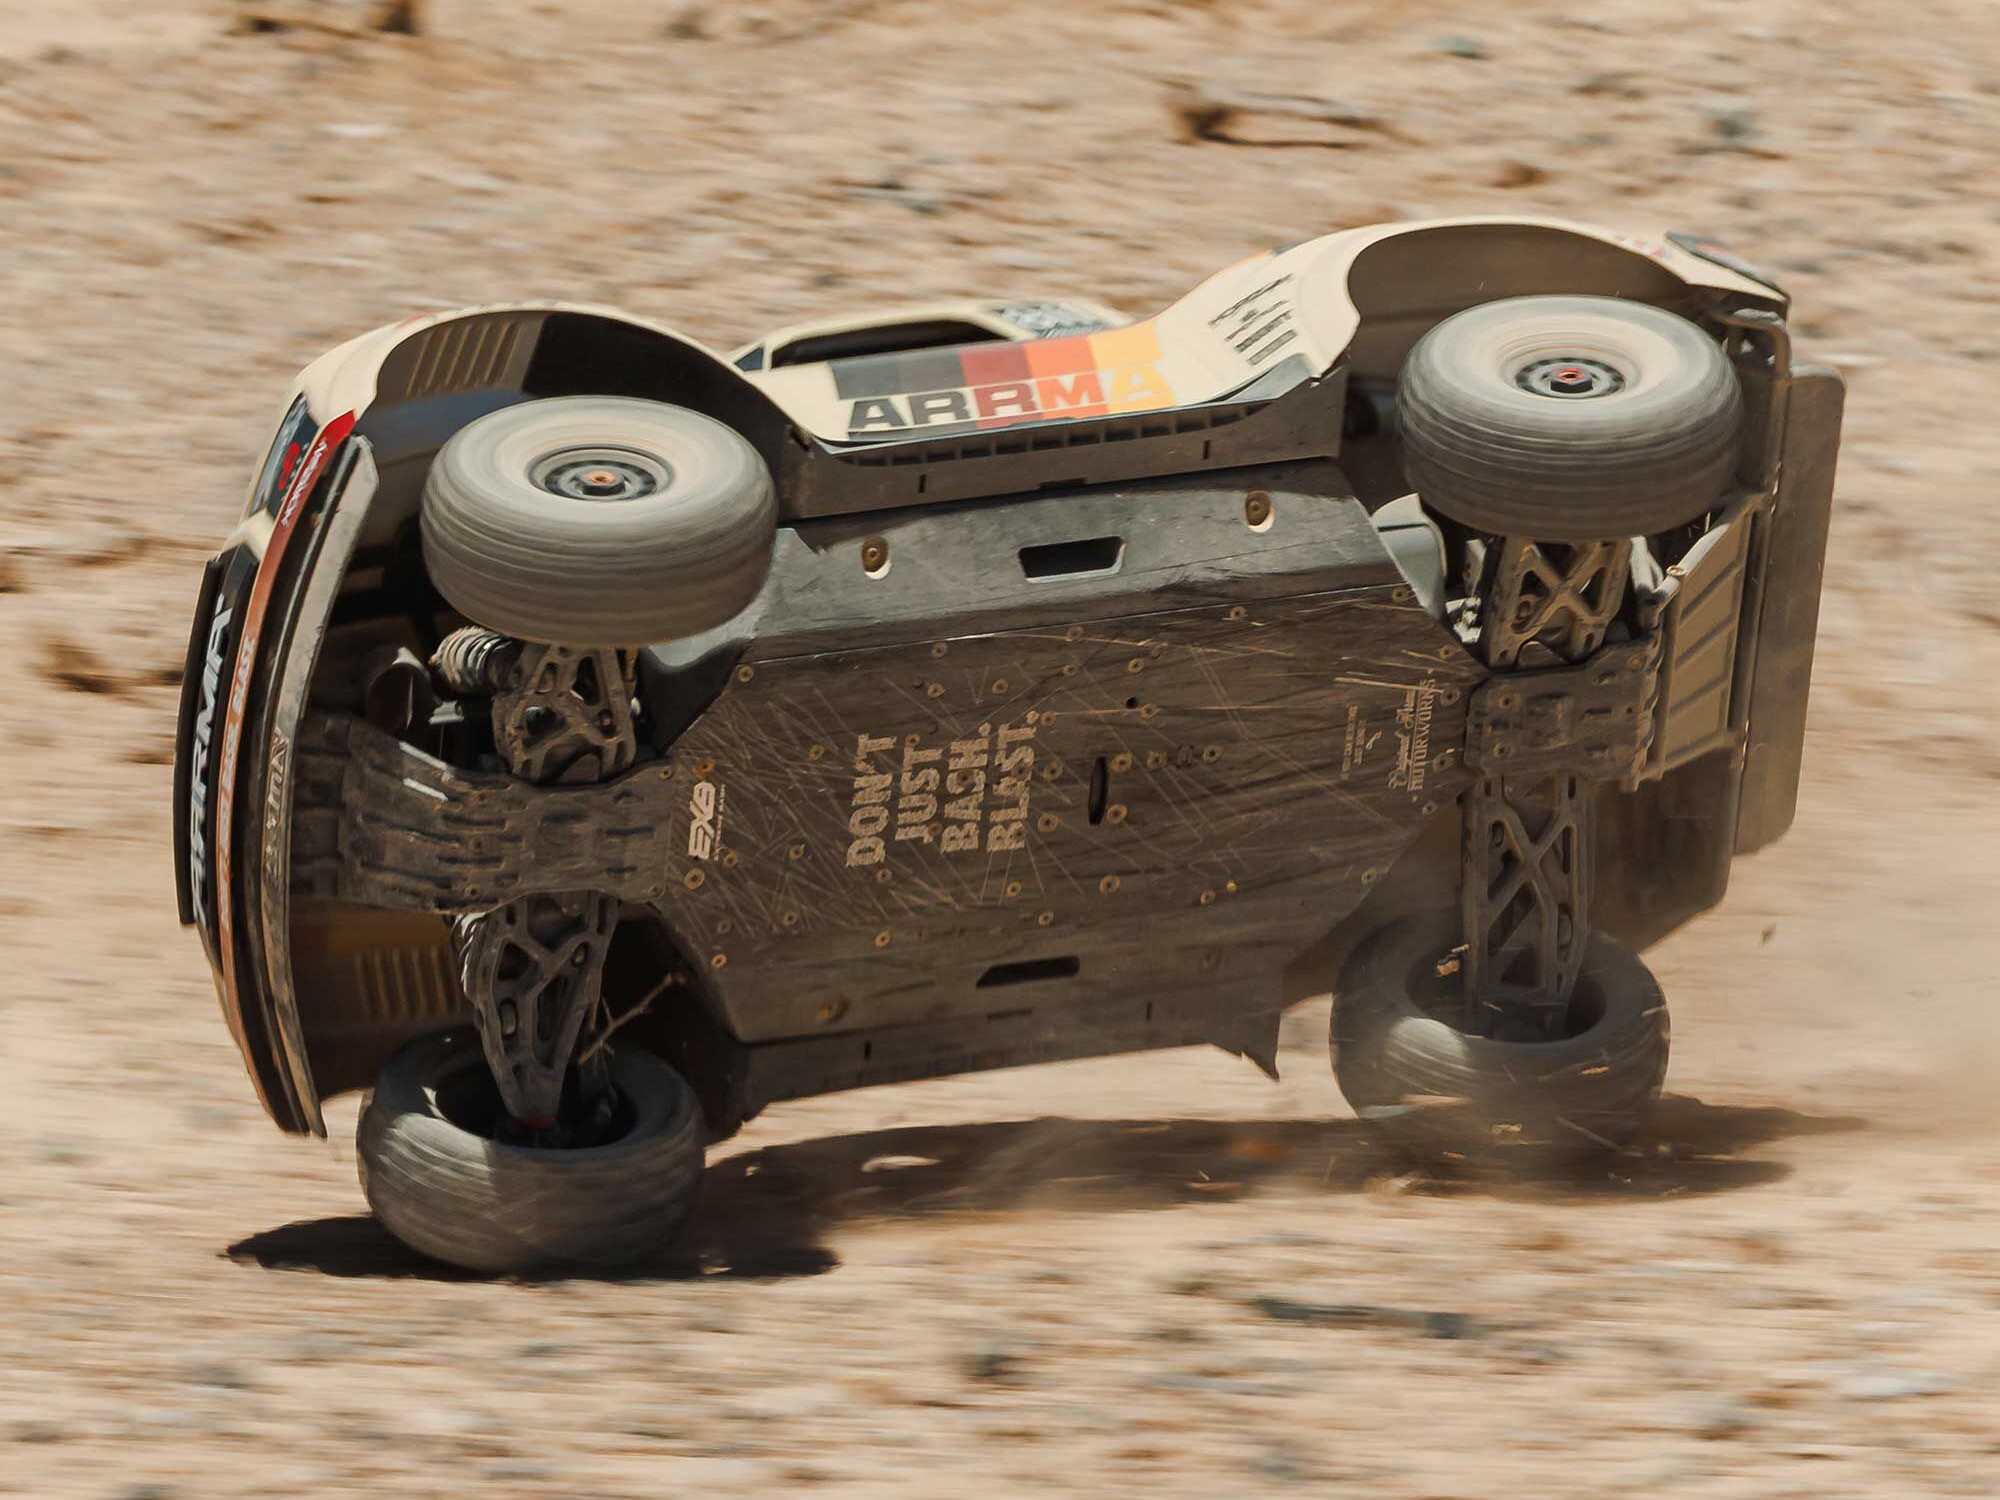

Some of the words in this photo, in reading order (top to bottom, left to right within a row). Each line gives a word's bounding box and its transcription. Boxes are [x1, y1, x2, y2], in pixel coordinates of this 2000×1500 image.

[847, 365, 1176, 433] ARRMA
[191, 592, 233, 930] ARRMA
[845, 733, 896, 868] DON'T
[895, 739, 942, 844] JUST
[941, 722, 991, 854] BASH.
[986, 710, 1040, 853] BLAST.
[1410, 679, 1436, 790] MOTORWORKS
